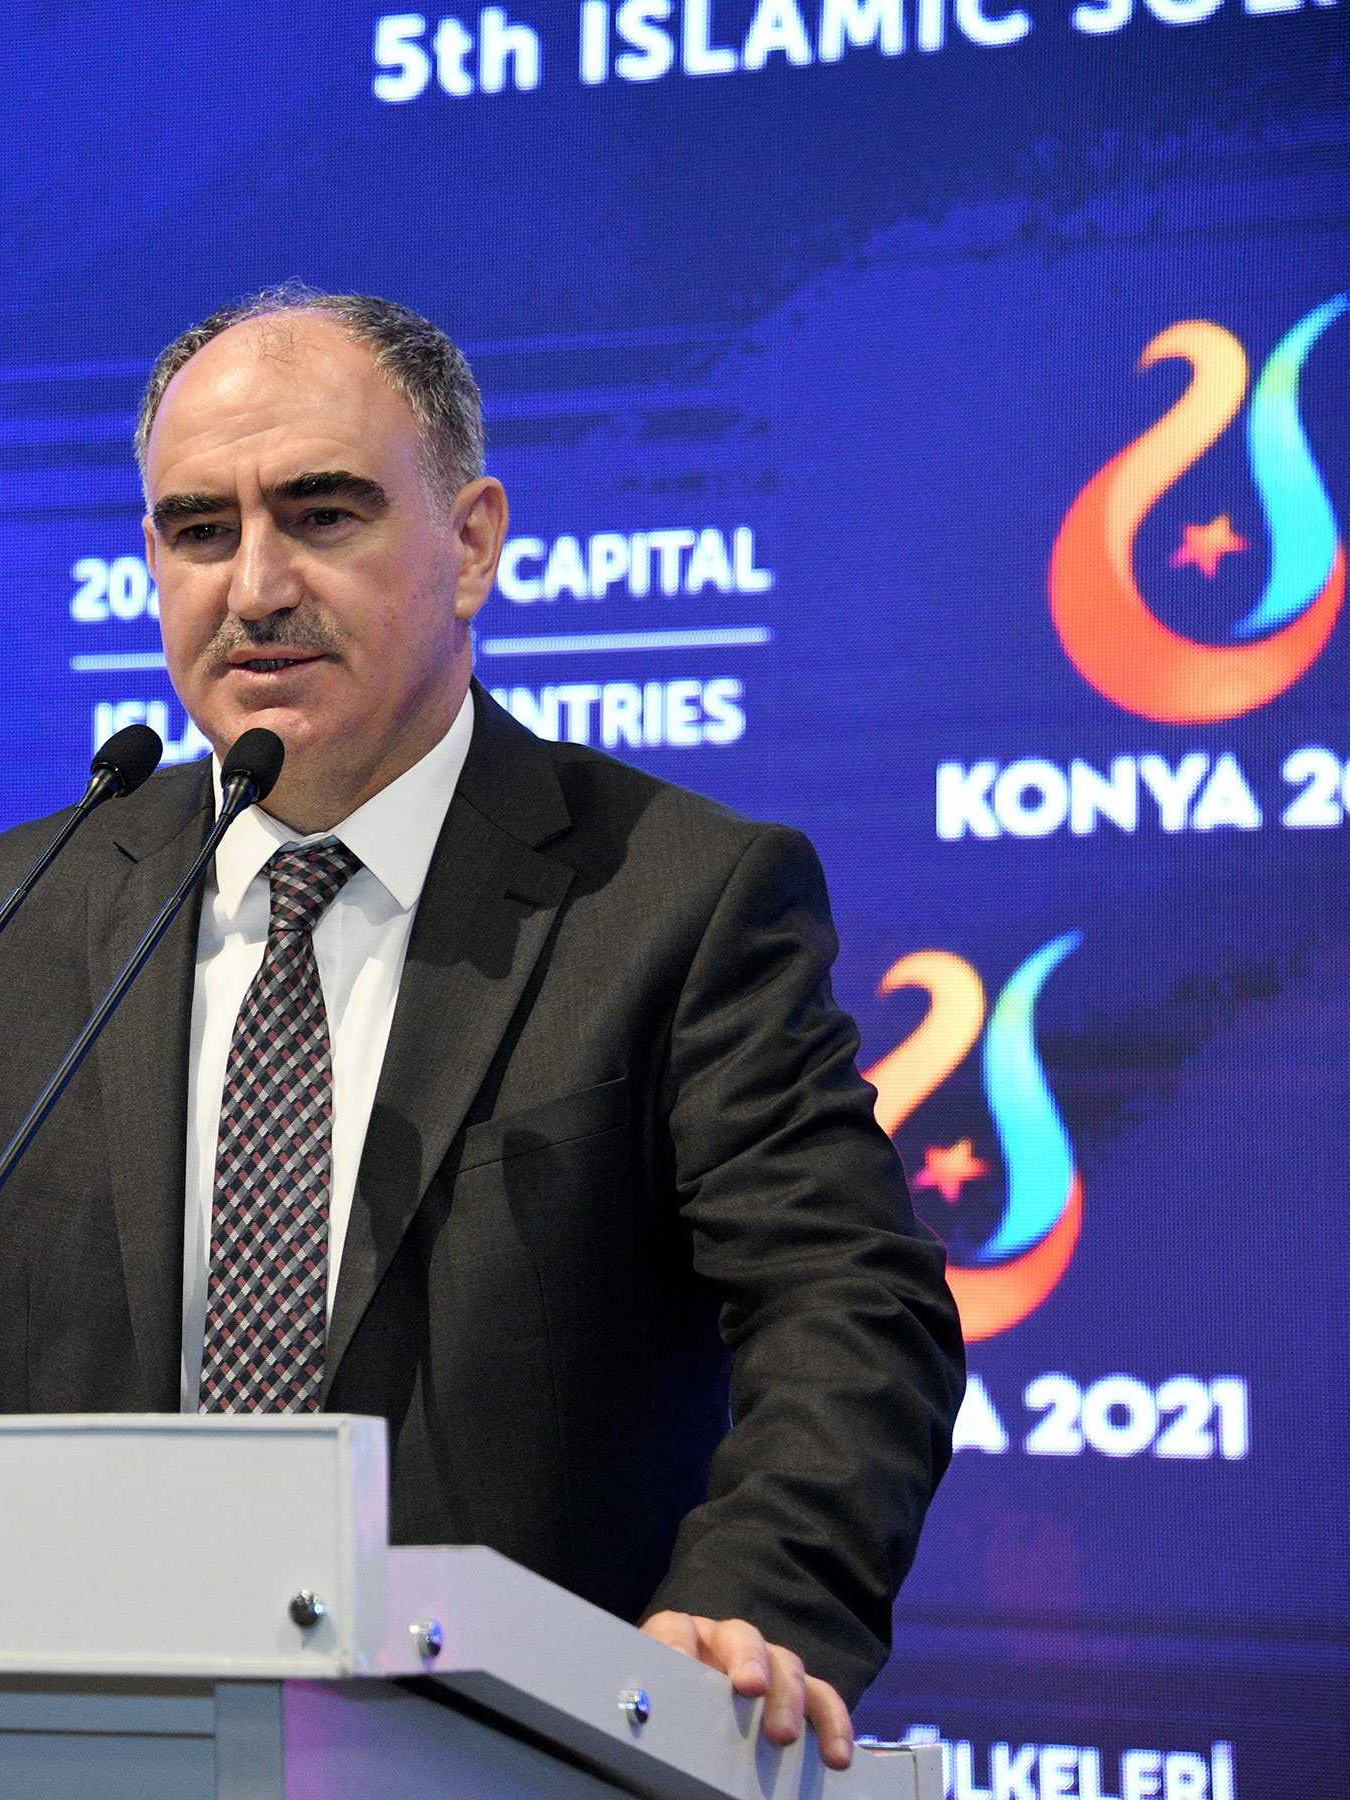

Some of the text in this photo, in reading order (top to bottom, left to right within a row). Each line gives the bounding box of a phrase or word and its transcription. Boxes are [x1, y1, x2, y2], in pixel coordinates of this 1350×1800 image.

[373, 6, 541, 103] 5th
[70, 527, 774, 622] 20 CAPITAL
[488, 677, 747, 748] NTRIES
[936, 744, 1350, 841] KONYA 2
[1021, 1370, 1250, 1461] 2021
